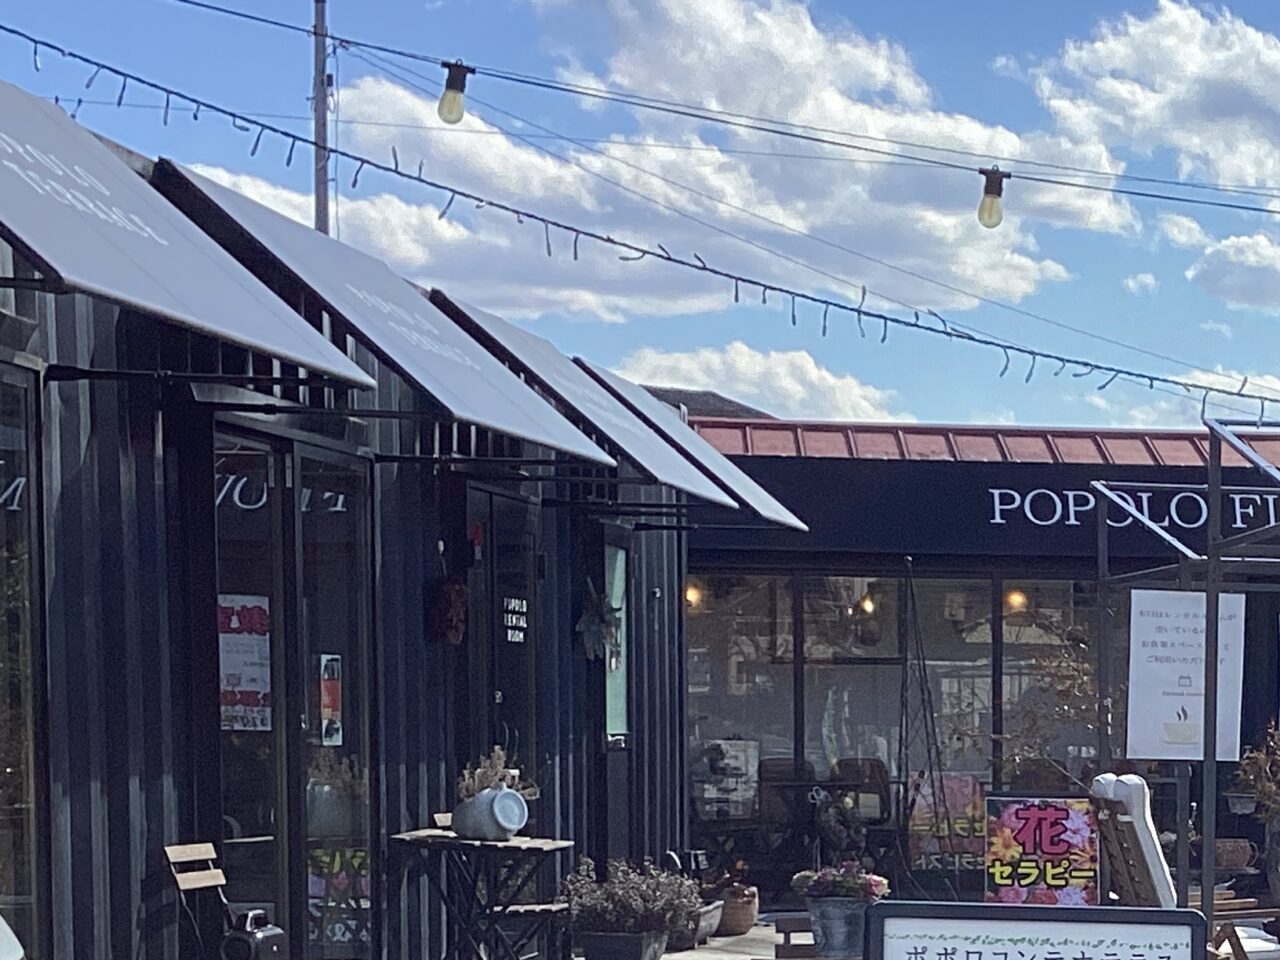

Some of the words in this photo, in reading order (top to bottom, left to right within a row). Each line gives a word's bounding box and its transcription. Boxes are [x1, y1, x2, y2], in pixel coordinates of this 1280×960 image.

[987, 488, 1209, 528] POPOLO
[1014, 804, 1070, 856] 花
[987, 859, 1098, 888] セラピー
